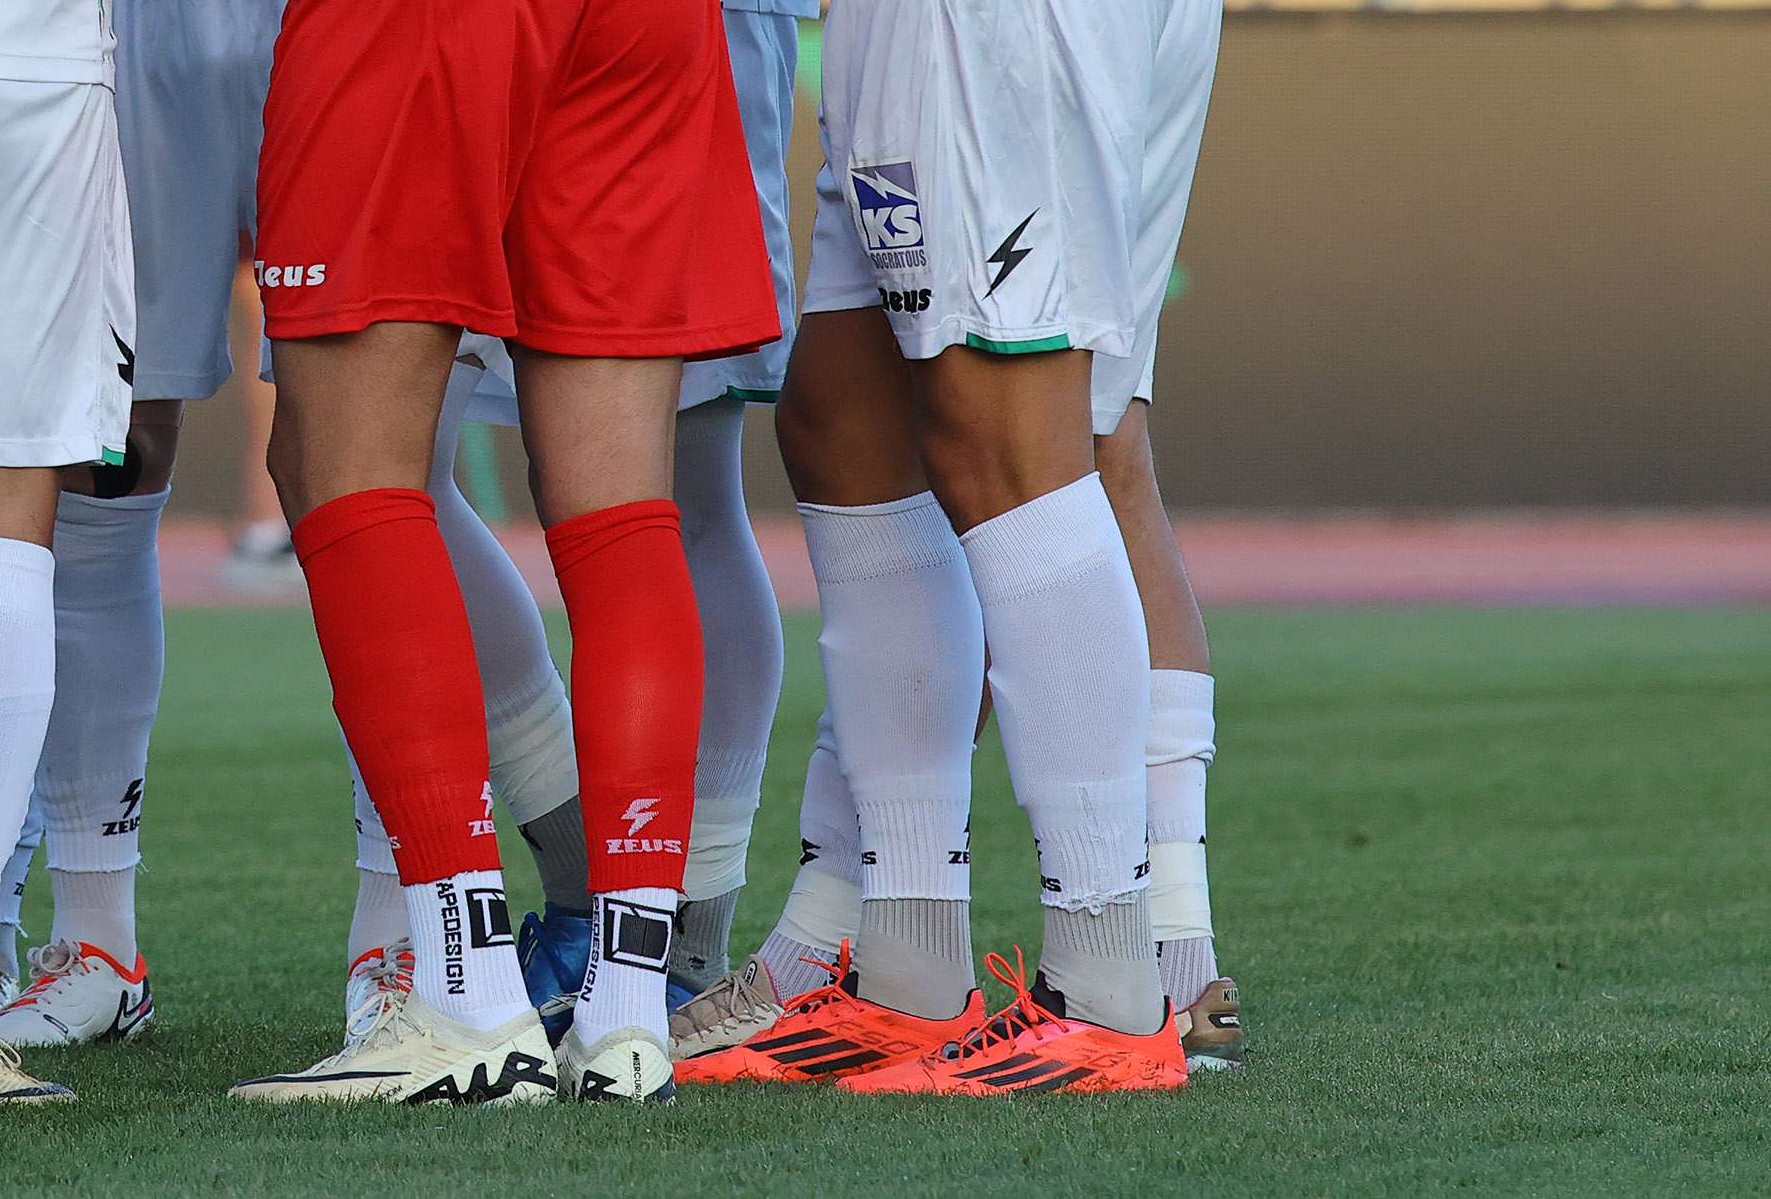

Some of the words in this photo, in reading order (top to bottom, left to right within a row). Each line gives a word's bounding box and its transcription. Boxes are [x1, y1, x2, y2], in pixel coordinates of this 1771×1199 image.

[862, 204, 922, 248] KS
[870, 250, 926, 270] SOCRATOUS
[606, 838, 683, 855] ZEUS
[436, 878, 466, 995] APEDESIGN
[580, 897, 600, 1003] PEDESIGN
[632, 1051, 642, 1101] MERCURIA
